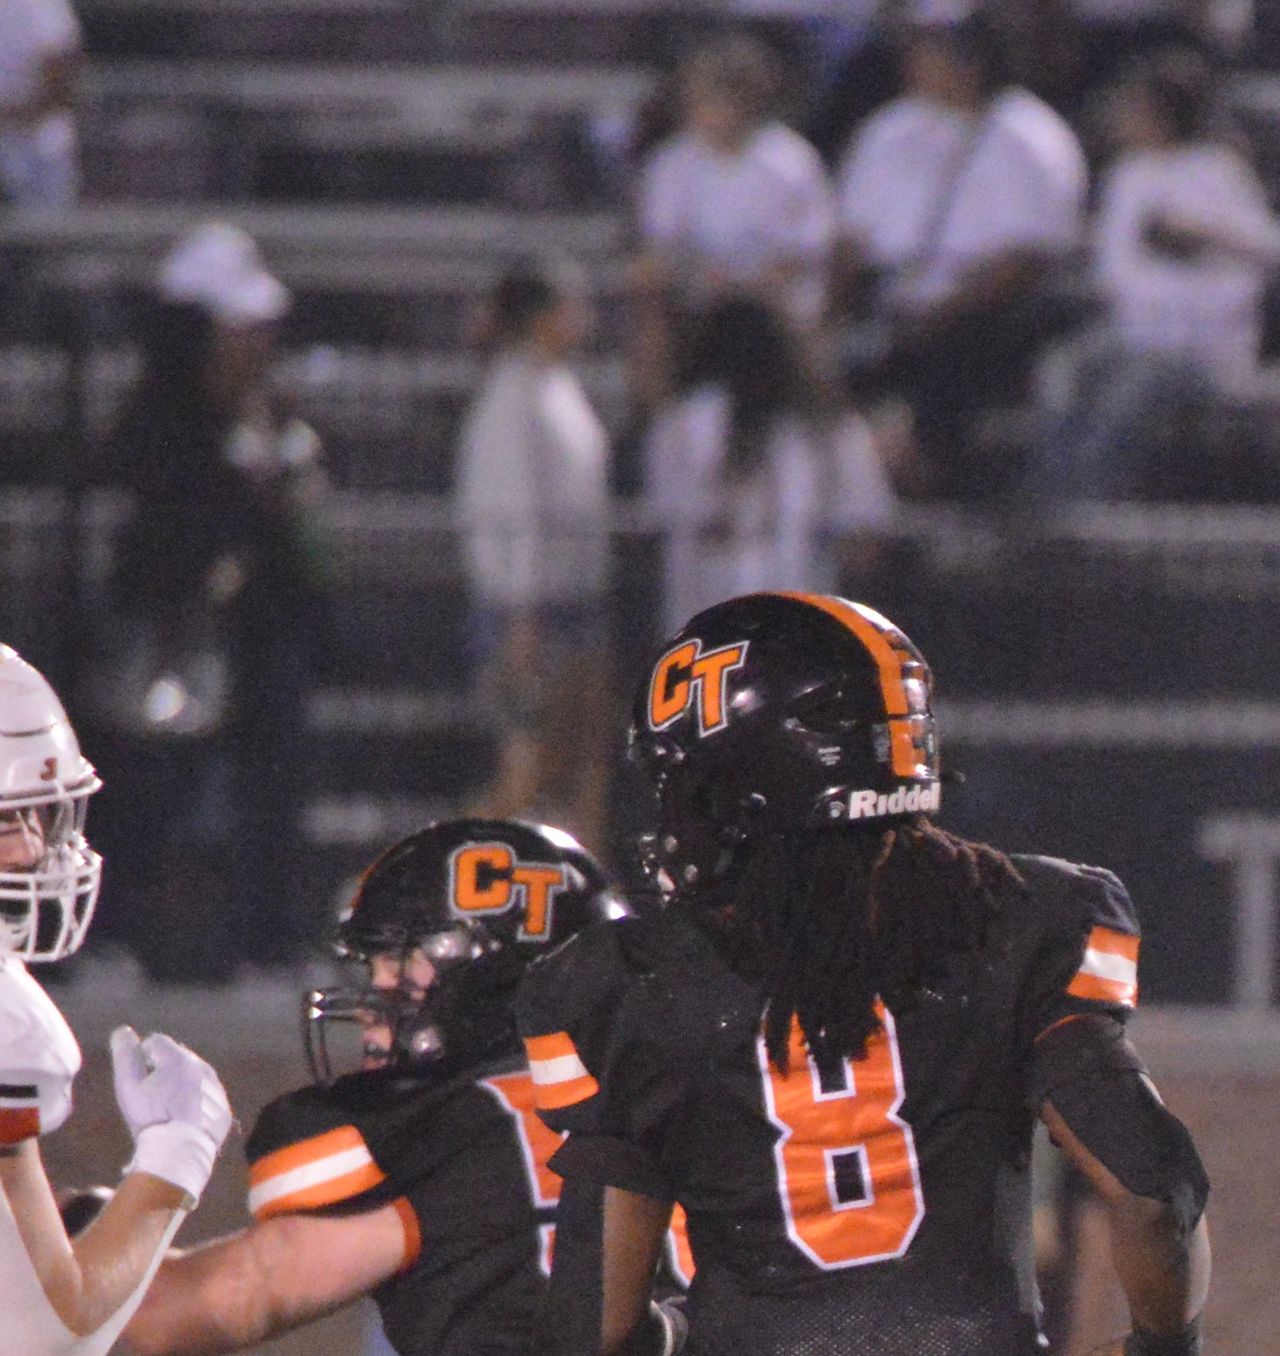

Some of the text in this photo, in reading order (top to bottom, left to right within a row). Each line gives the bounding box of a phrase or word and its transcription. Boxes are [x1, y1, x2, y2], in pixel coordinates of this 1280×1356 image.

[647, 637, 750, 738] CT
[448, 840, 567, 942] CT
[755, 992, 926, 1271] 8
